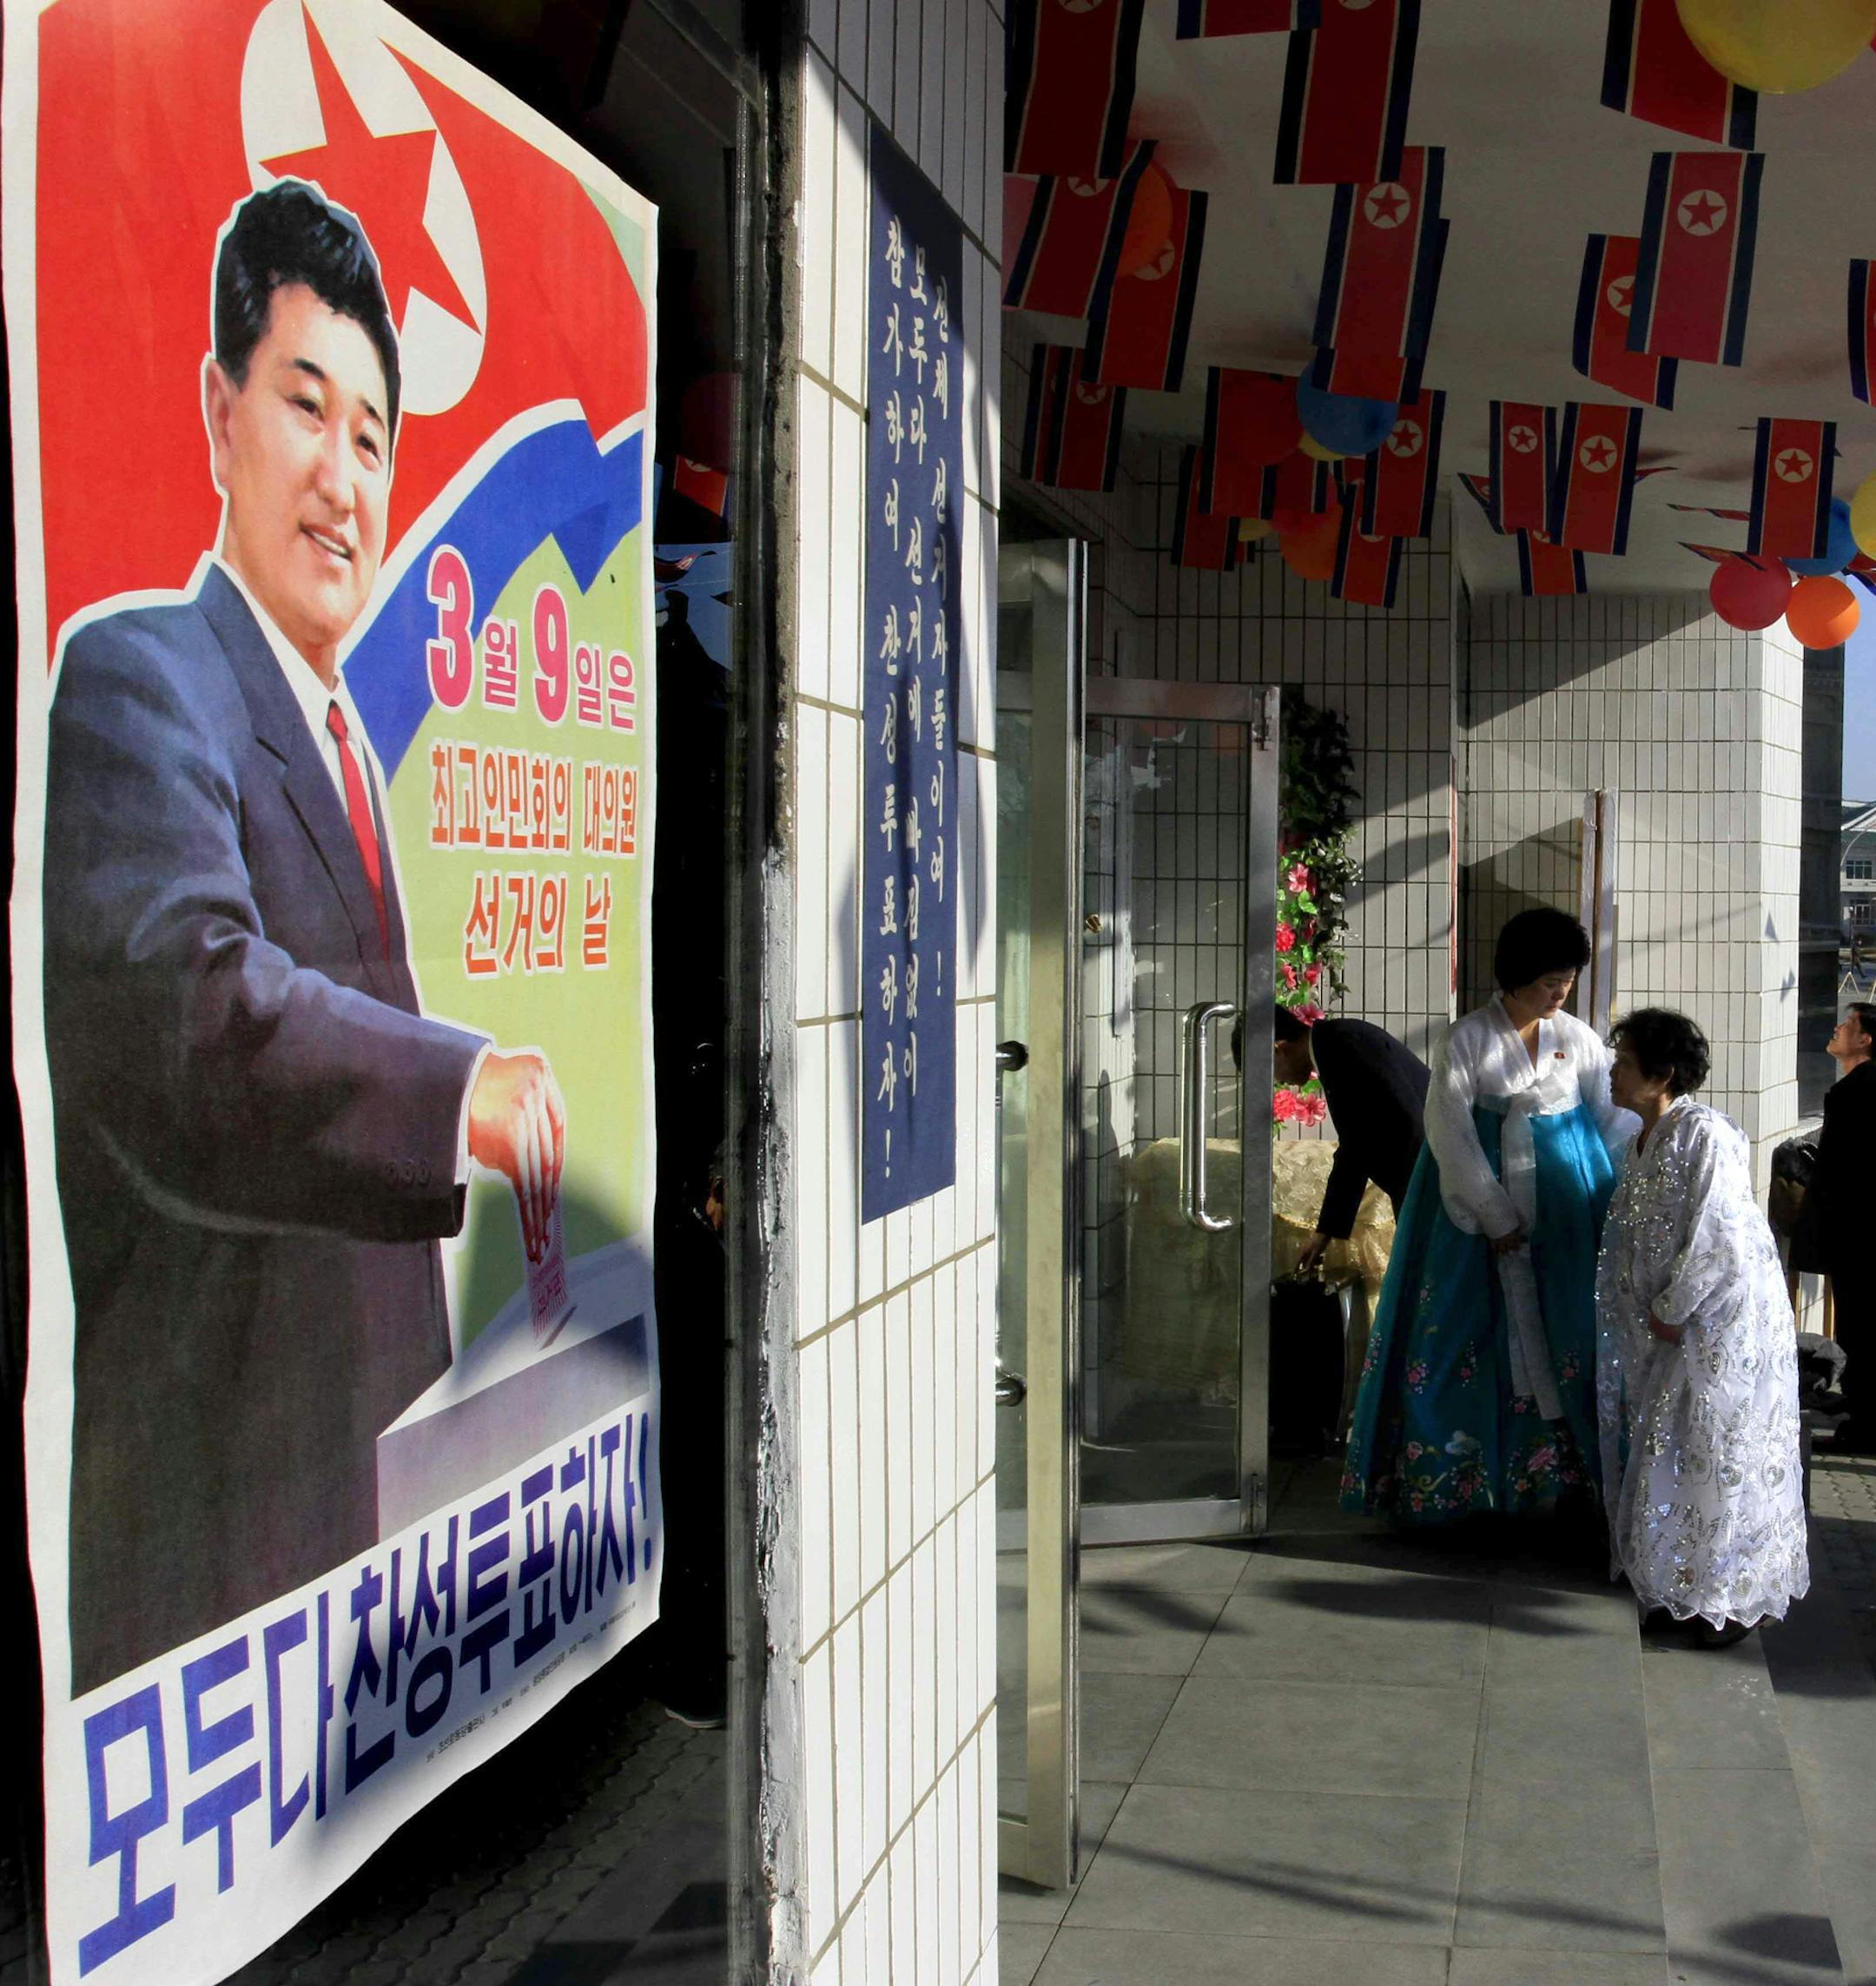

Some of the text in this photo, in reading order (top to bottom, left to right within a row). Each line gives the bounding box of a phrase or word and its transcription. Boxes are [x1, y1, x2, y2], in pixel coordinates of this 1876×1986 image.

[882, 215, 905, 551] 참가하여
[932, 276, 949, 419] 전체
[427, 549, 636, 730] 3월 9일은
[903, 244, 928, 1097] 모두다 선거에 빠짐없이
[432, 745, 636, 854] 최고인민회의 대의원
[466, 874, 611, 975] 선거의 날
